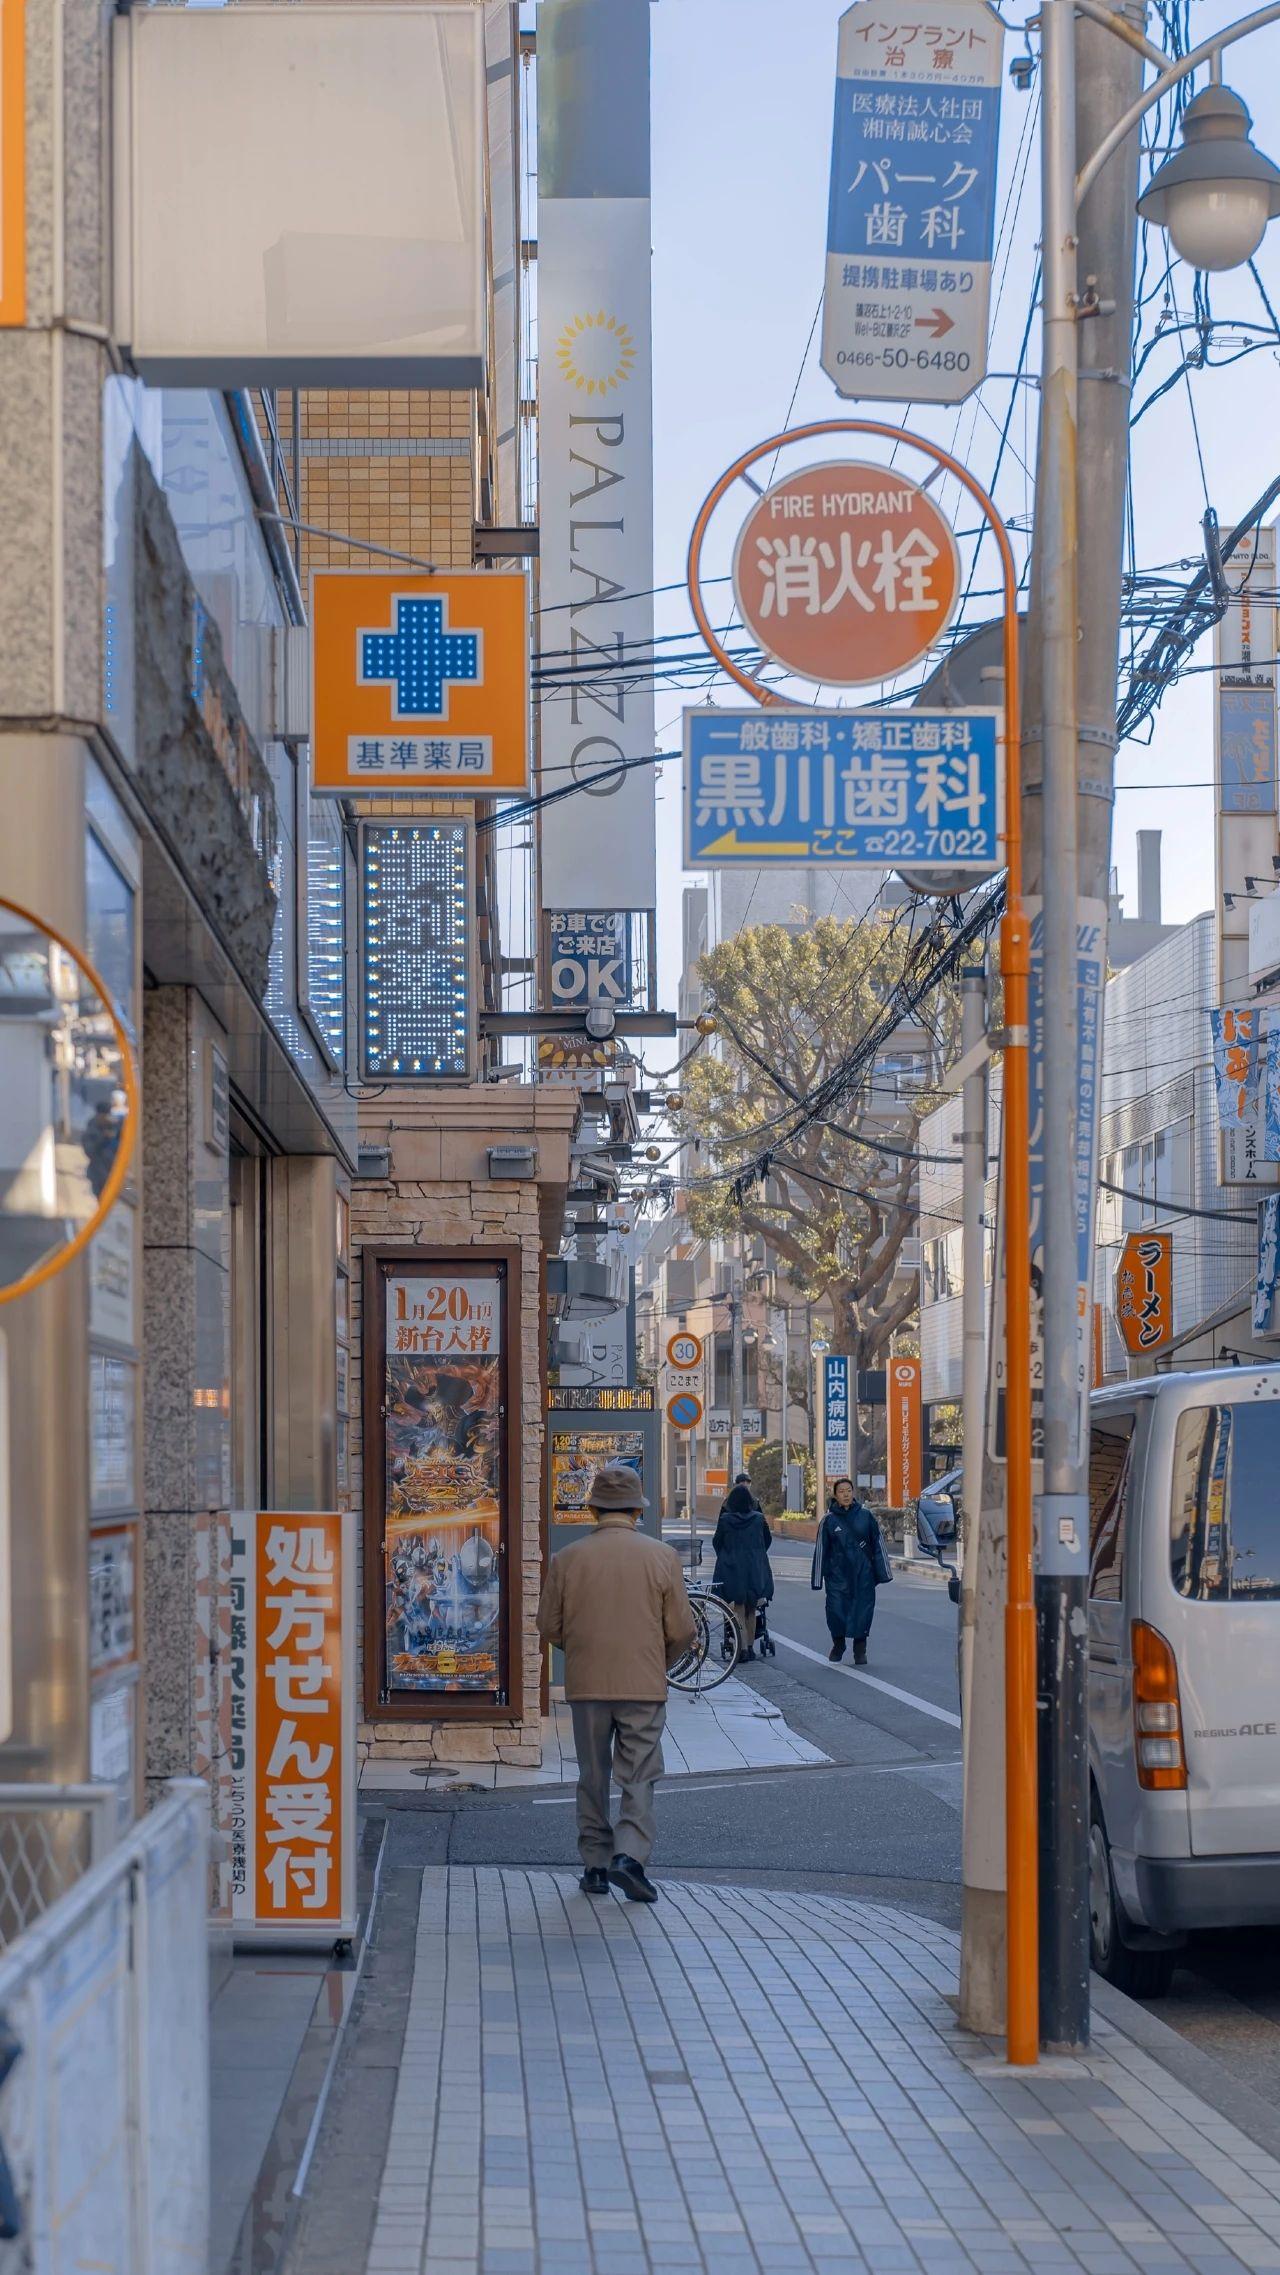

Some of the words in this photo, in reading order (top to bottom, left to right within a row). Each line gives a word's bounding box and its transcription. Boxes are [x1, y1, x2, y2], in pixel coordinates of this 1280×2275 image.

[856, 22, 986, 49] インプラント
[852, 92, 983, 121] 医療法人社団
[863, 117, 973, 144] 湘南誠心会
[848, 158, 979, 202] パーク
[842, 264, 974, 294] 提携駐車場あり
[836, 347, 970, 372] 0466-50-6480
[770, 495, 814, 519] FIRE
[822, 490, 914, 517] HYDRANT
[755, 528, 939, 618] 消火栓
[568, 412, 628, 798] PALAZZO
[709, 721, 972, 752] 一般歯科・矯正歯科
[356, 740, 485, 770] 基準薬局
[695, 754, 986, 828] 黒川歯科
[811, 829, 859, 856] ここ
[550, 913, 616, 932] お車での
[558, 935, 616, 956] ご来店
[551, 958, 627, 999] OK
[1137, 1240, 1164, 1348] ラーメン
[395, 1325, 493, 1353] 新台入替
[675, 1343, 695, 1359] 30
[670, 1375, 699, 1387] ここまで
[828, 1360, 847, 1438] 山内病院
[264, 1525, 335, 1910] 処方せん受付
